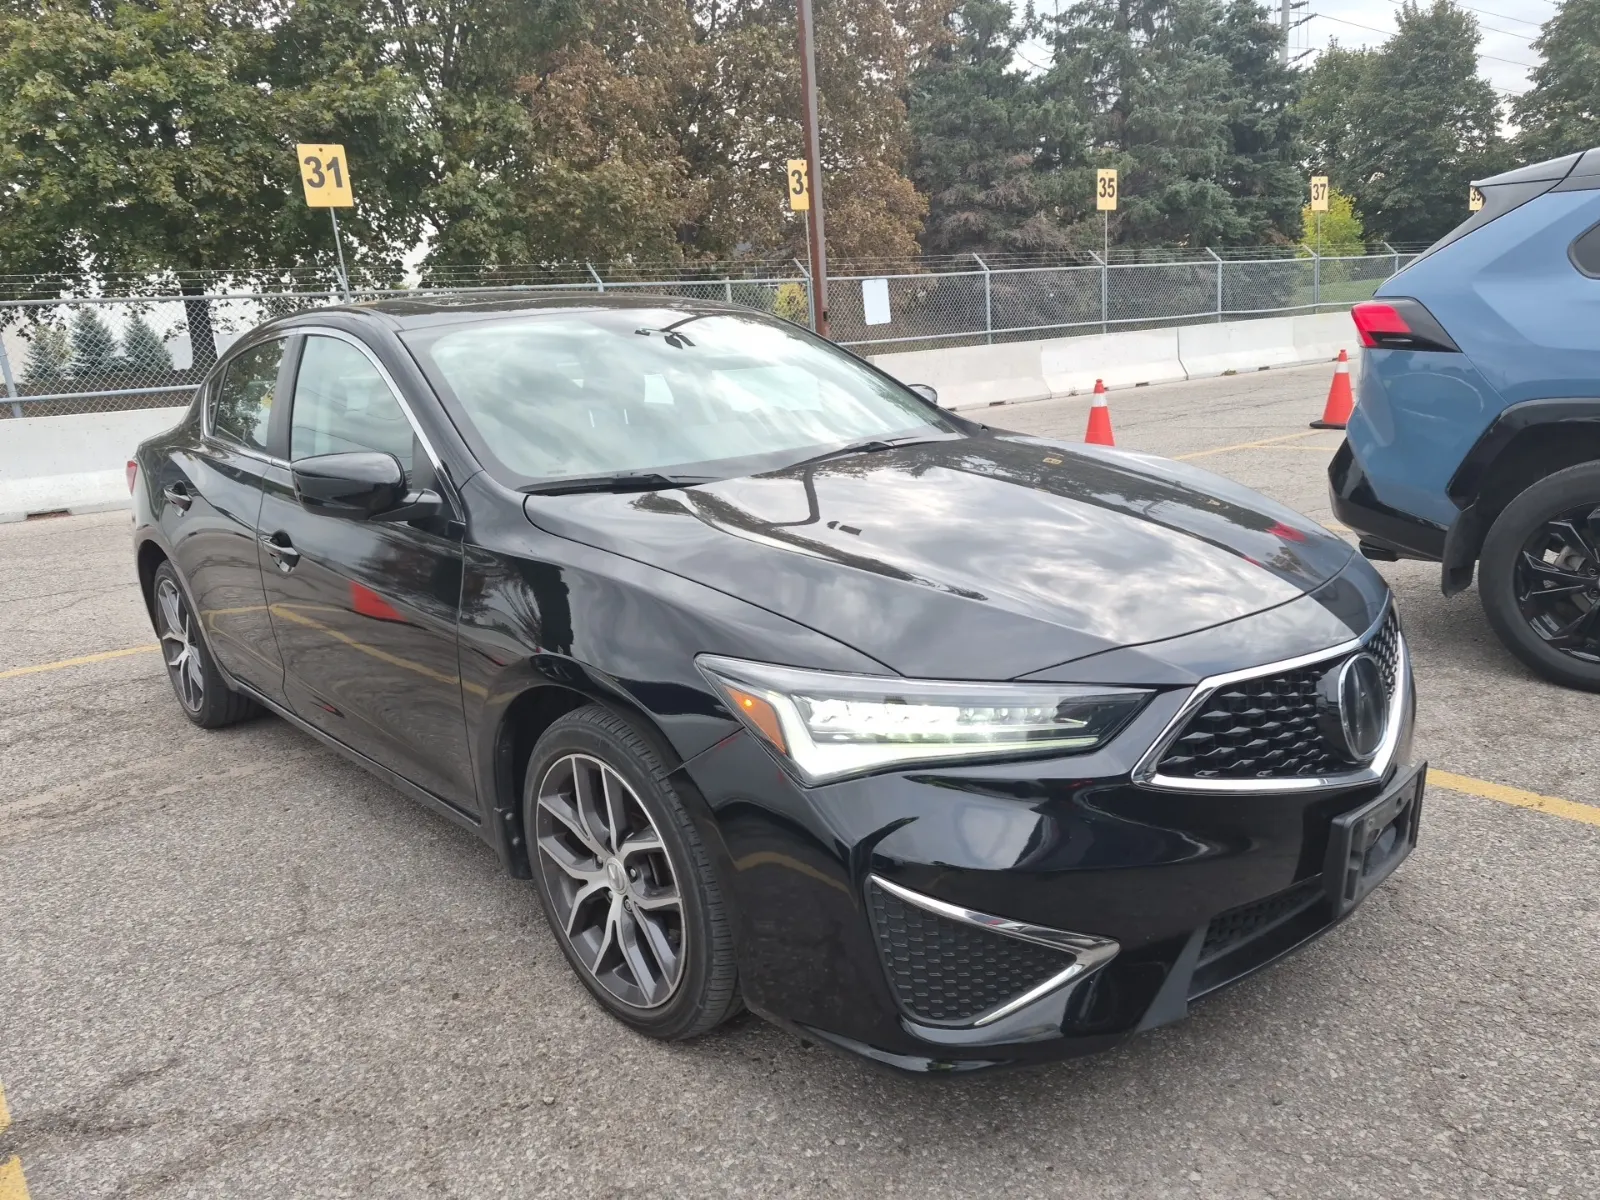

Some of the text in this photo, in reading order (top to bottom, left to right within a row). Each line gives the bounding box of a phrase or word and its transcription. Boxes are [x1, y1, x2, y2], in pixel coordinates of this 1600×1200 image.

[304, 156, 343, 188] 31
[1099, 177, 1115, 198] 35
[1313, 184, 1326, 200] 37
